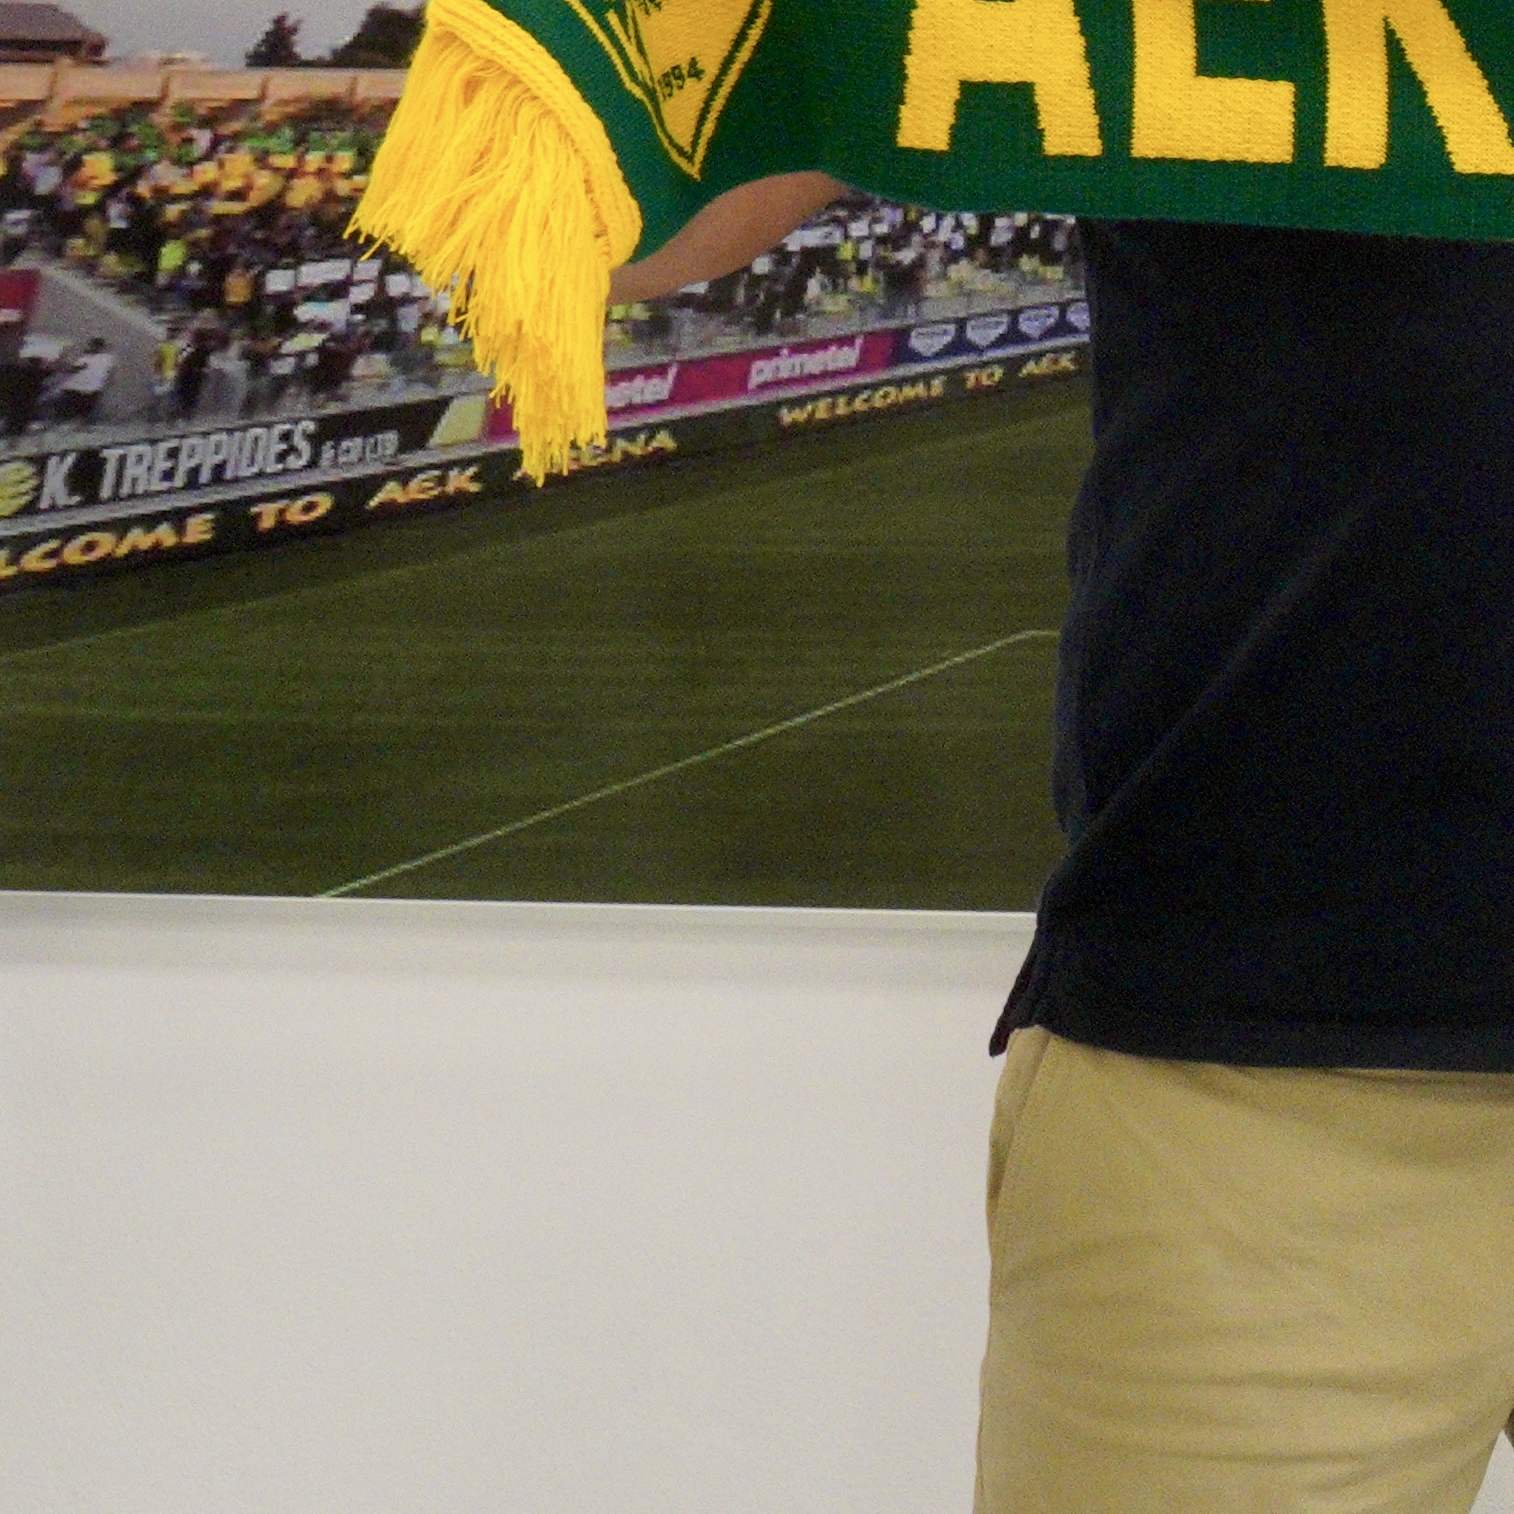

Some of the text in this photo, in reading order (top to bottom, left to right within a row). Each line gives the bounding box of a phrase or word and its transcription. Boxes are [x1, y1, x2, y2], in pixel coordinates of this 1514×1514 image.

[778, 351, 1077, 426] WELCOME TO AEK
[100, 419, 318, 502] TREPPIDES
[250, 491, 334, 533] TO
[366, 466, 482, 510] AEK
